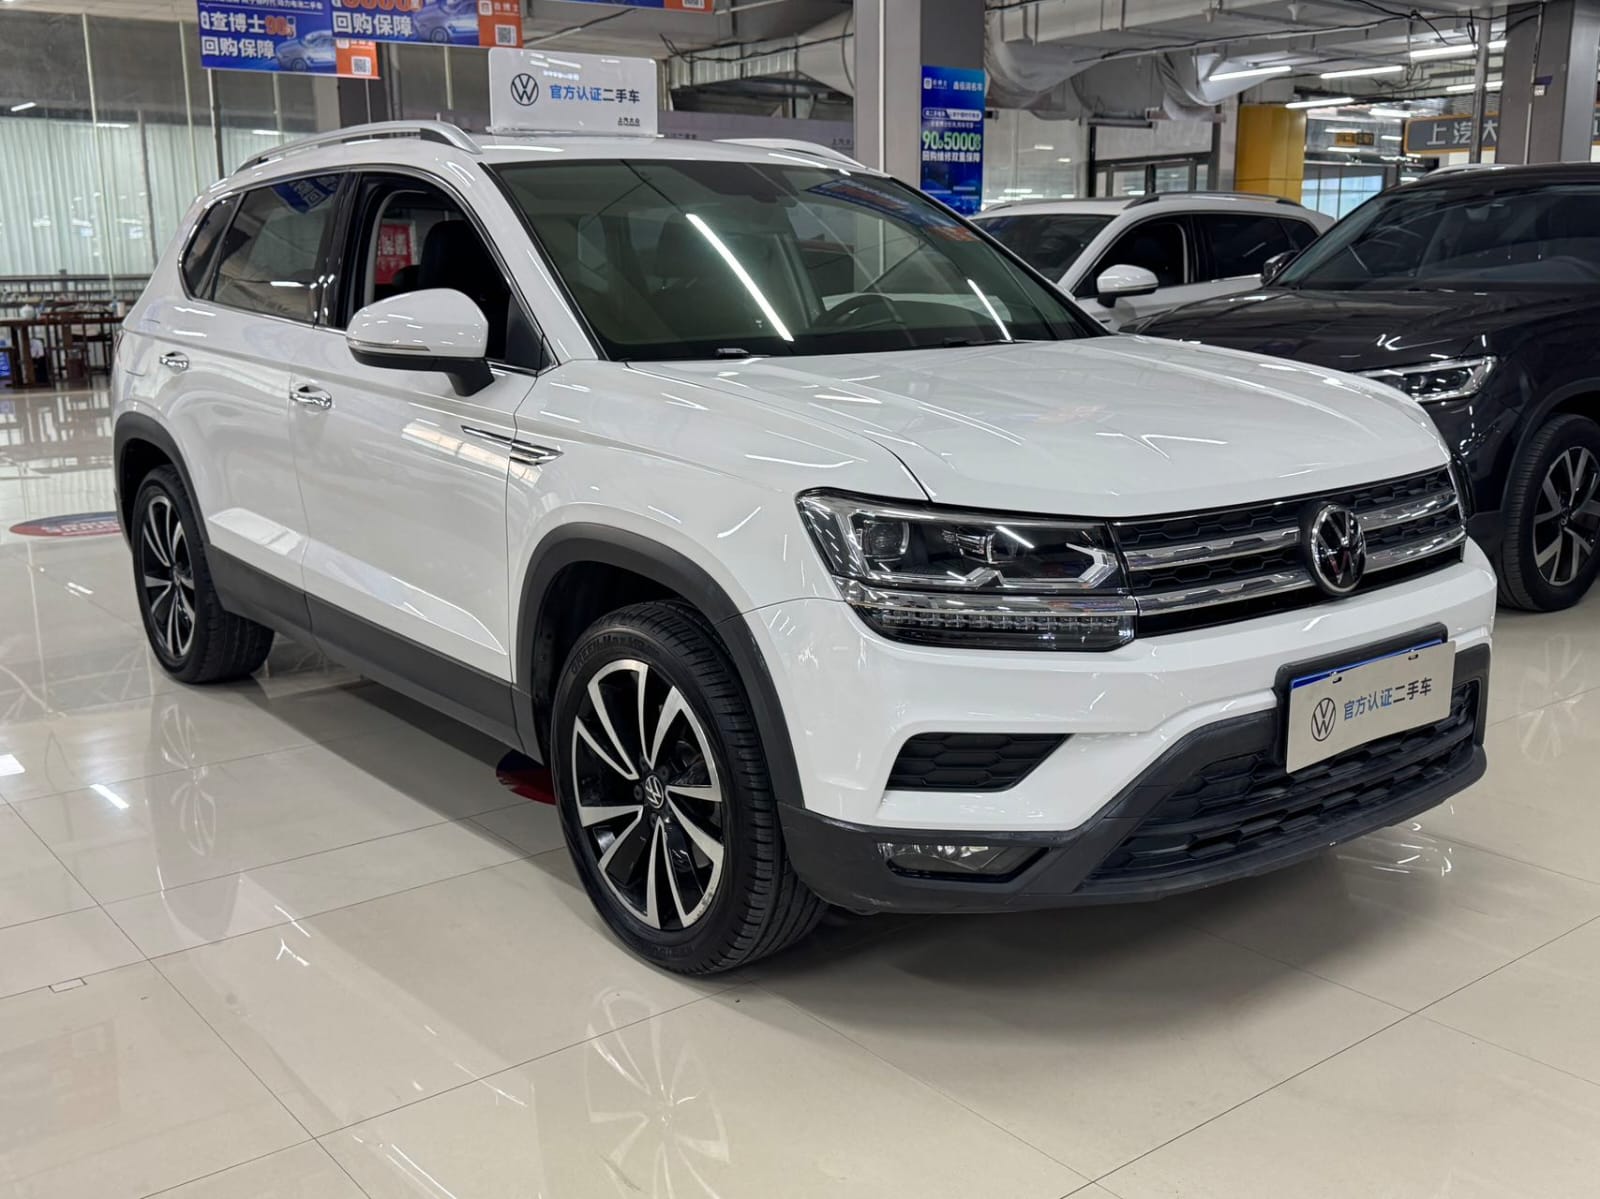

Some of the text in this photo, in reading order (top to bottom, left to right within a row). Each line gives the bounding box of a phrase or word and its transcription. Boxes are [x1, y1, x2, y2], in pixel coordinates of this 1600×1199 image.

[332, 11, 412, 37] 回购保障
[201, 36, 275, 59] 回购保障
[550, 84, 640, 103] 官方认证二手车
[1343, 677, 1433, 721] 官方认证二手车
